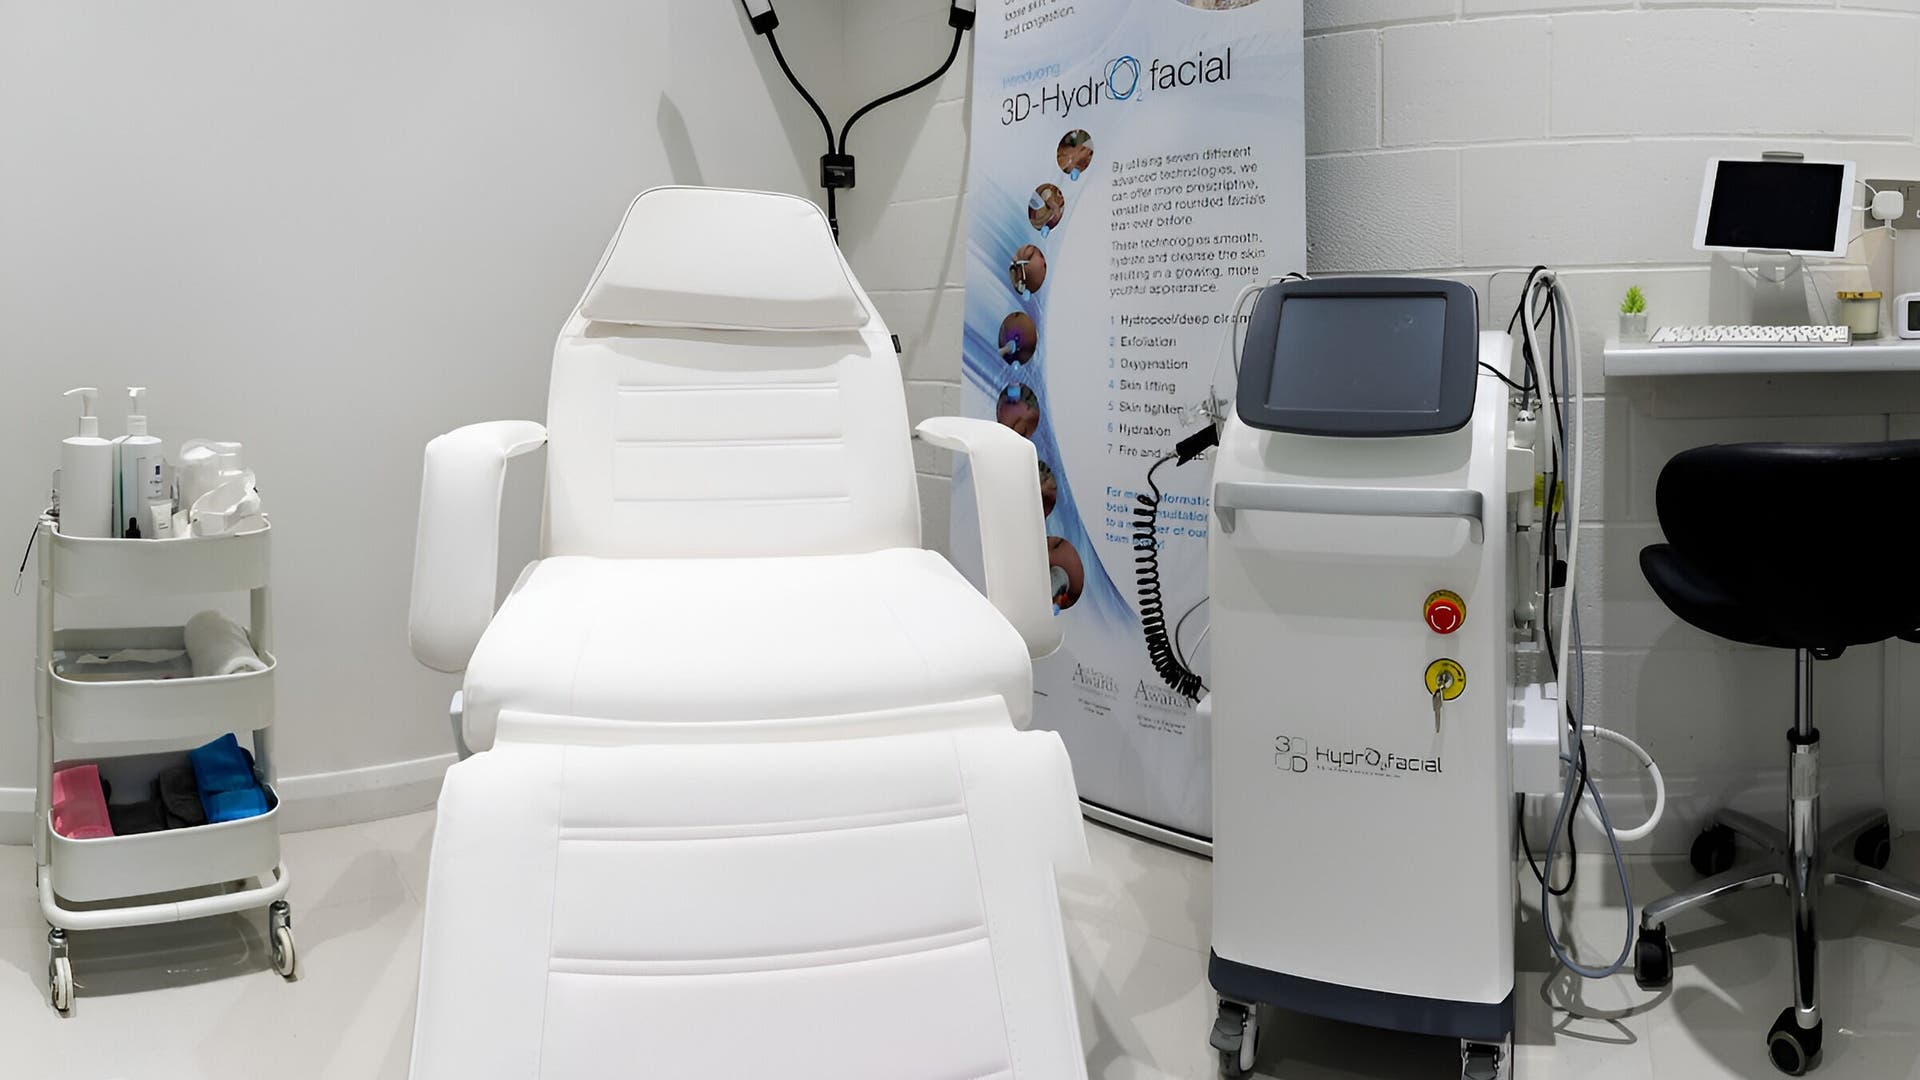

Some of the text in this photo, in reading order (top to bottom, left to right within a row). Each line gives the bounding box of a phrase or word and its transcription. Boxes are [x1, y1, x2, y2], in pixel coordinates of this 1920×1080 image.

[1149, 47, 1232, 91] facial
[1166, 152, 1199, 164] seven
[1202, 146, 1251, 160] different
[1240, 163, 1258, 173] we
[1154, 185, 1183, 196] more
[1152, 200, 1172, 212] and
[1175, 197, 1223, 210] rounded
[1148, 252, 1167, 264] and
[1171, 251, 1215, 262] cleanse
[1218, 249, 1238, 260] the
[1241, 247, 1266, 259] skin
[1227, 265, 1259, 276] more
[1120, 336, 1177, 348] Exfoliation
[1120, 358, 1189, 371] Oxygenation
[1119, 379, 1142, 391] Skin
[1145, 381, 1176, 394] lifting
[1119, 401, 1142, 412] Skin
[1119, 423, 1171, 437] Hydration
[1119, 445, 1138, 456] Fire
[1140, 448, 1161, 459] and
[1106, 486, 1121, 497] For
